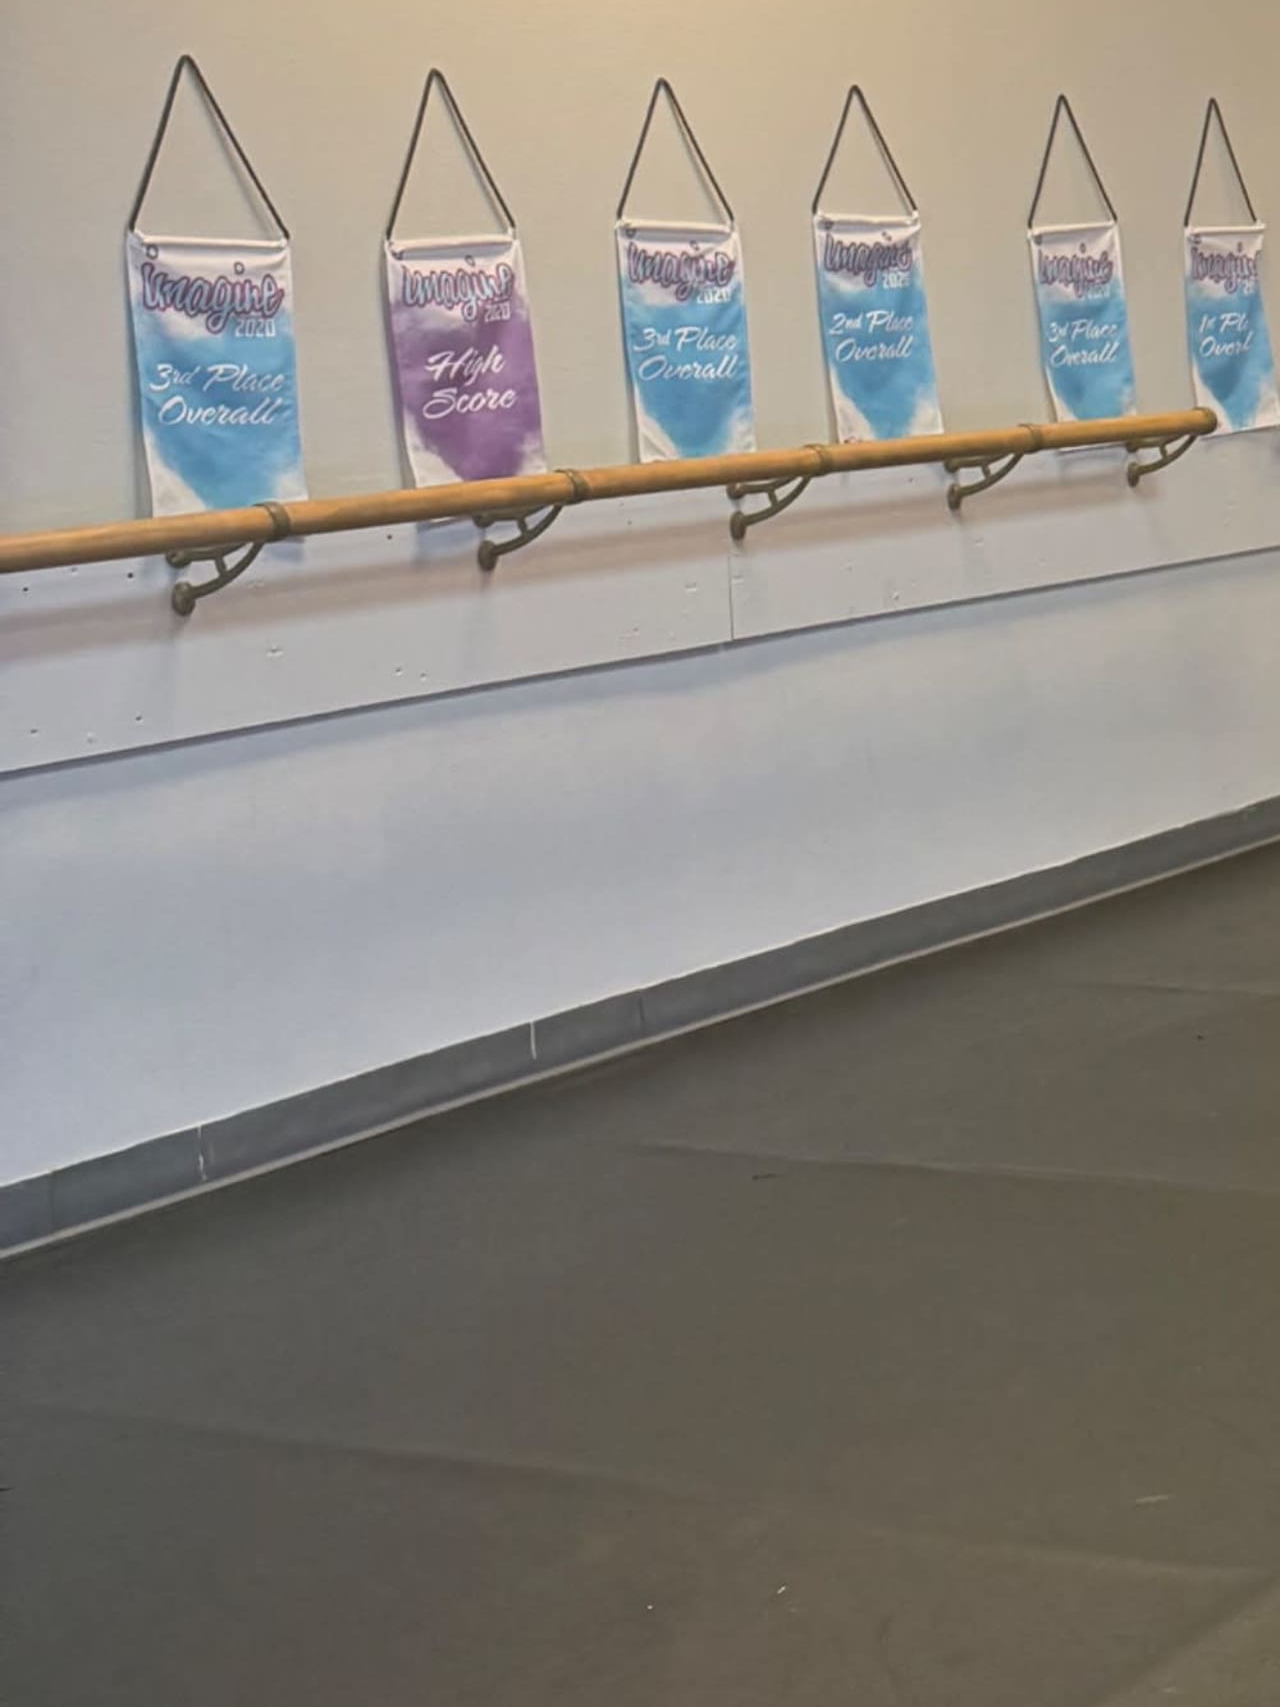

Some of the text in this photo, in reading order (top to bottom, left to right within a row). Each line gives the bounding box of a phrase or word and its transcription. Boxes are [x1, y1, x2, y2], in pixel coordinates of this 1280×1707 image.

[235, 318, 276, 338] 2020
[828, 309, 914, 335] 2nd Place
[633, 326, 738, 351] 3rd Place
[835, 335, 914, 363] Overall
[424, 344, 505, 386] High
[638, 354, 739, 381] Overall
[1050, 341, 1120, 367] Overall
[150, 363, 285, 392] 3rd Place
[158, 395, 283, 425] Overall
[422, 387, 517, 419] Score
